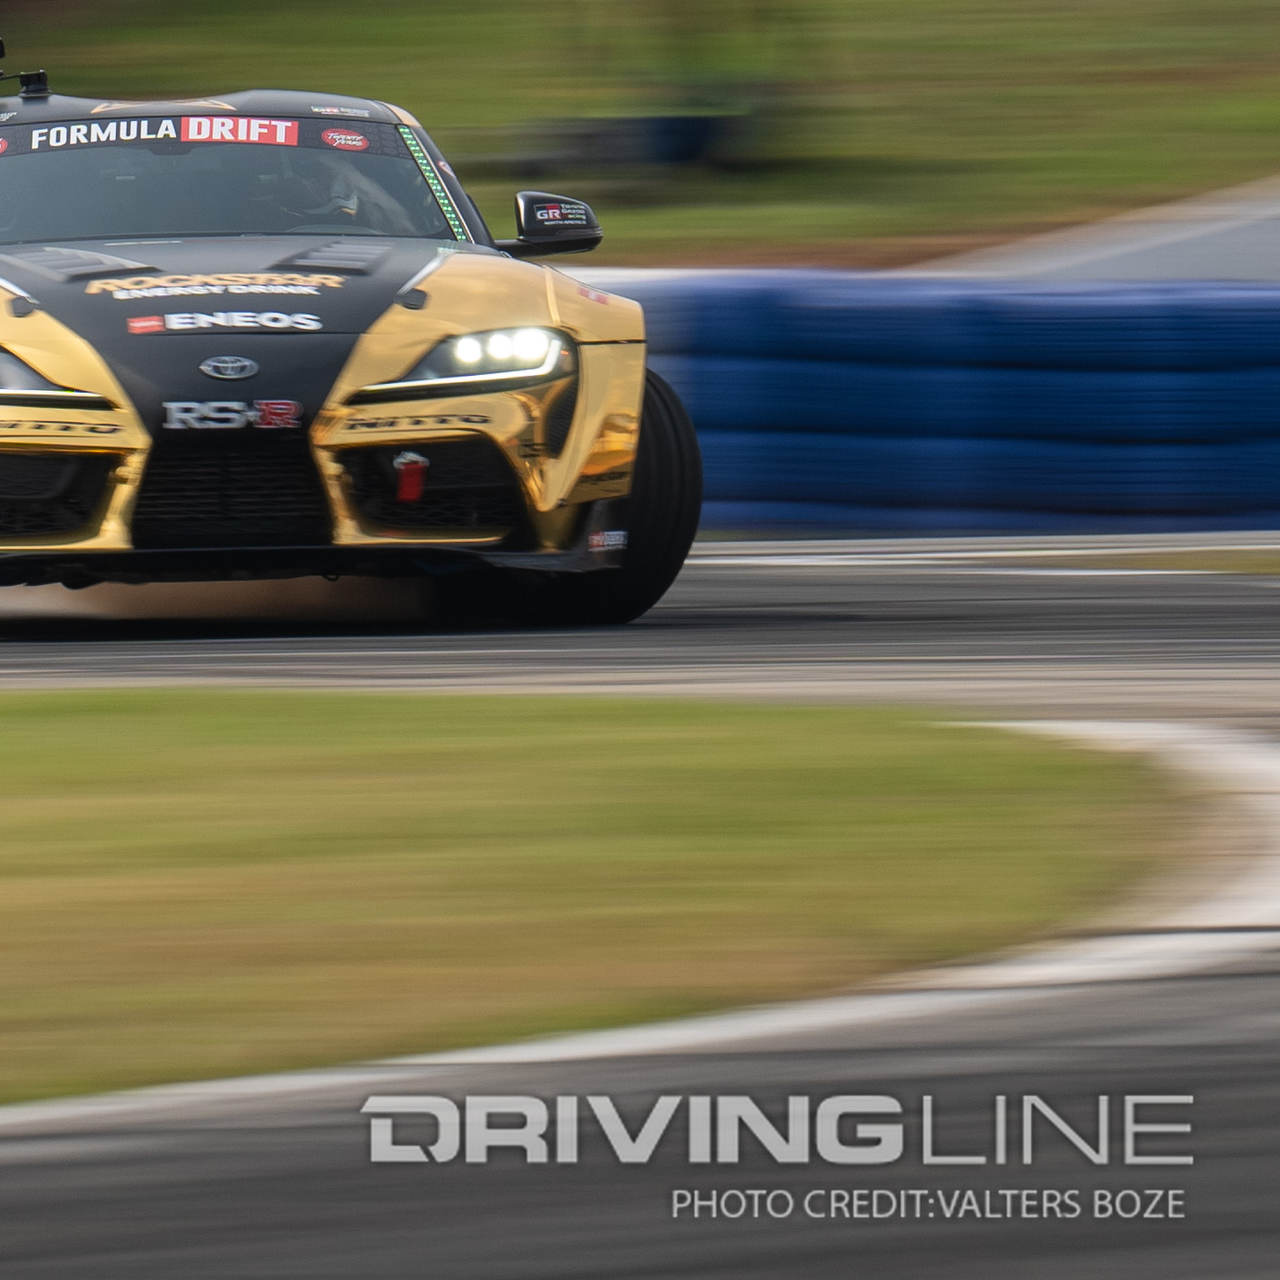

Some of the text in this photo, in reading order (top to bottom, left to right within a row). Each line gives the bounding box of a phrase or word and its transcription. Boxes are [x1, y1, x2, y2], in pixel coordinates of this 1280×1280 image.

[31, 117, 292, 149] FORMULA DRIFT
[536, 209, 561, 219] GR
[164, 311, 323, 331] ENEOS
